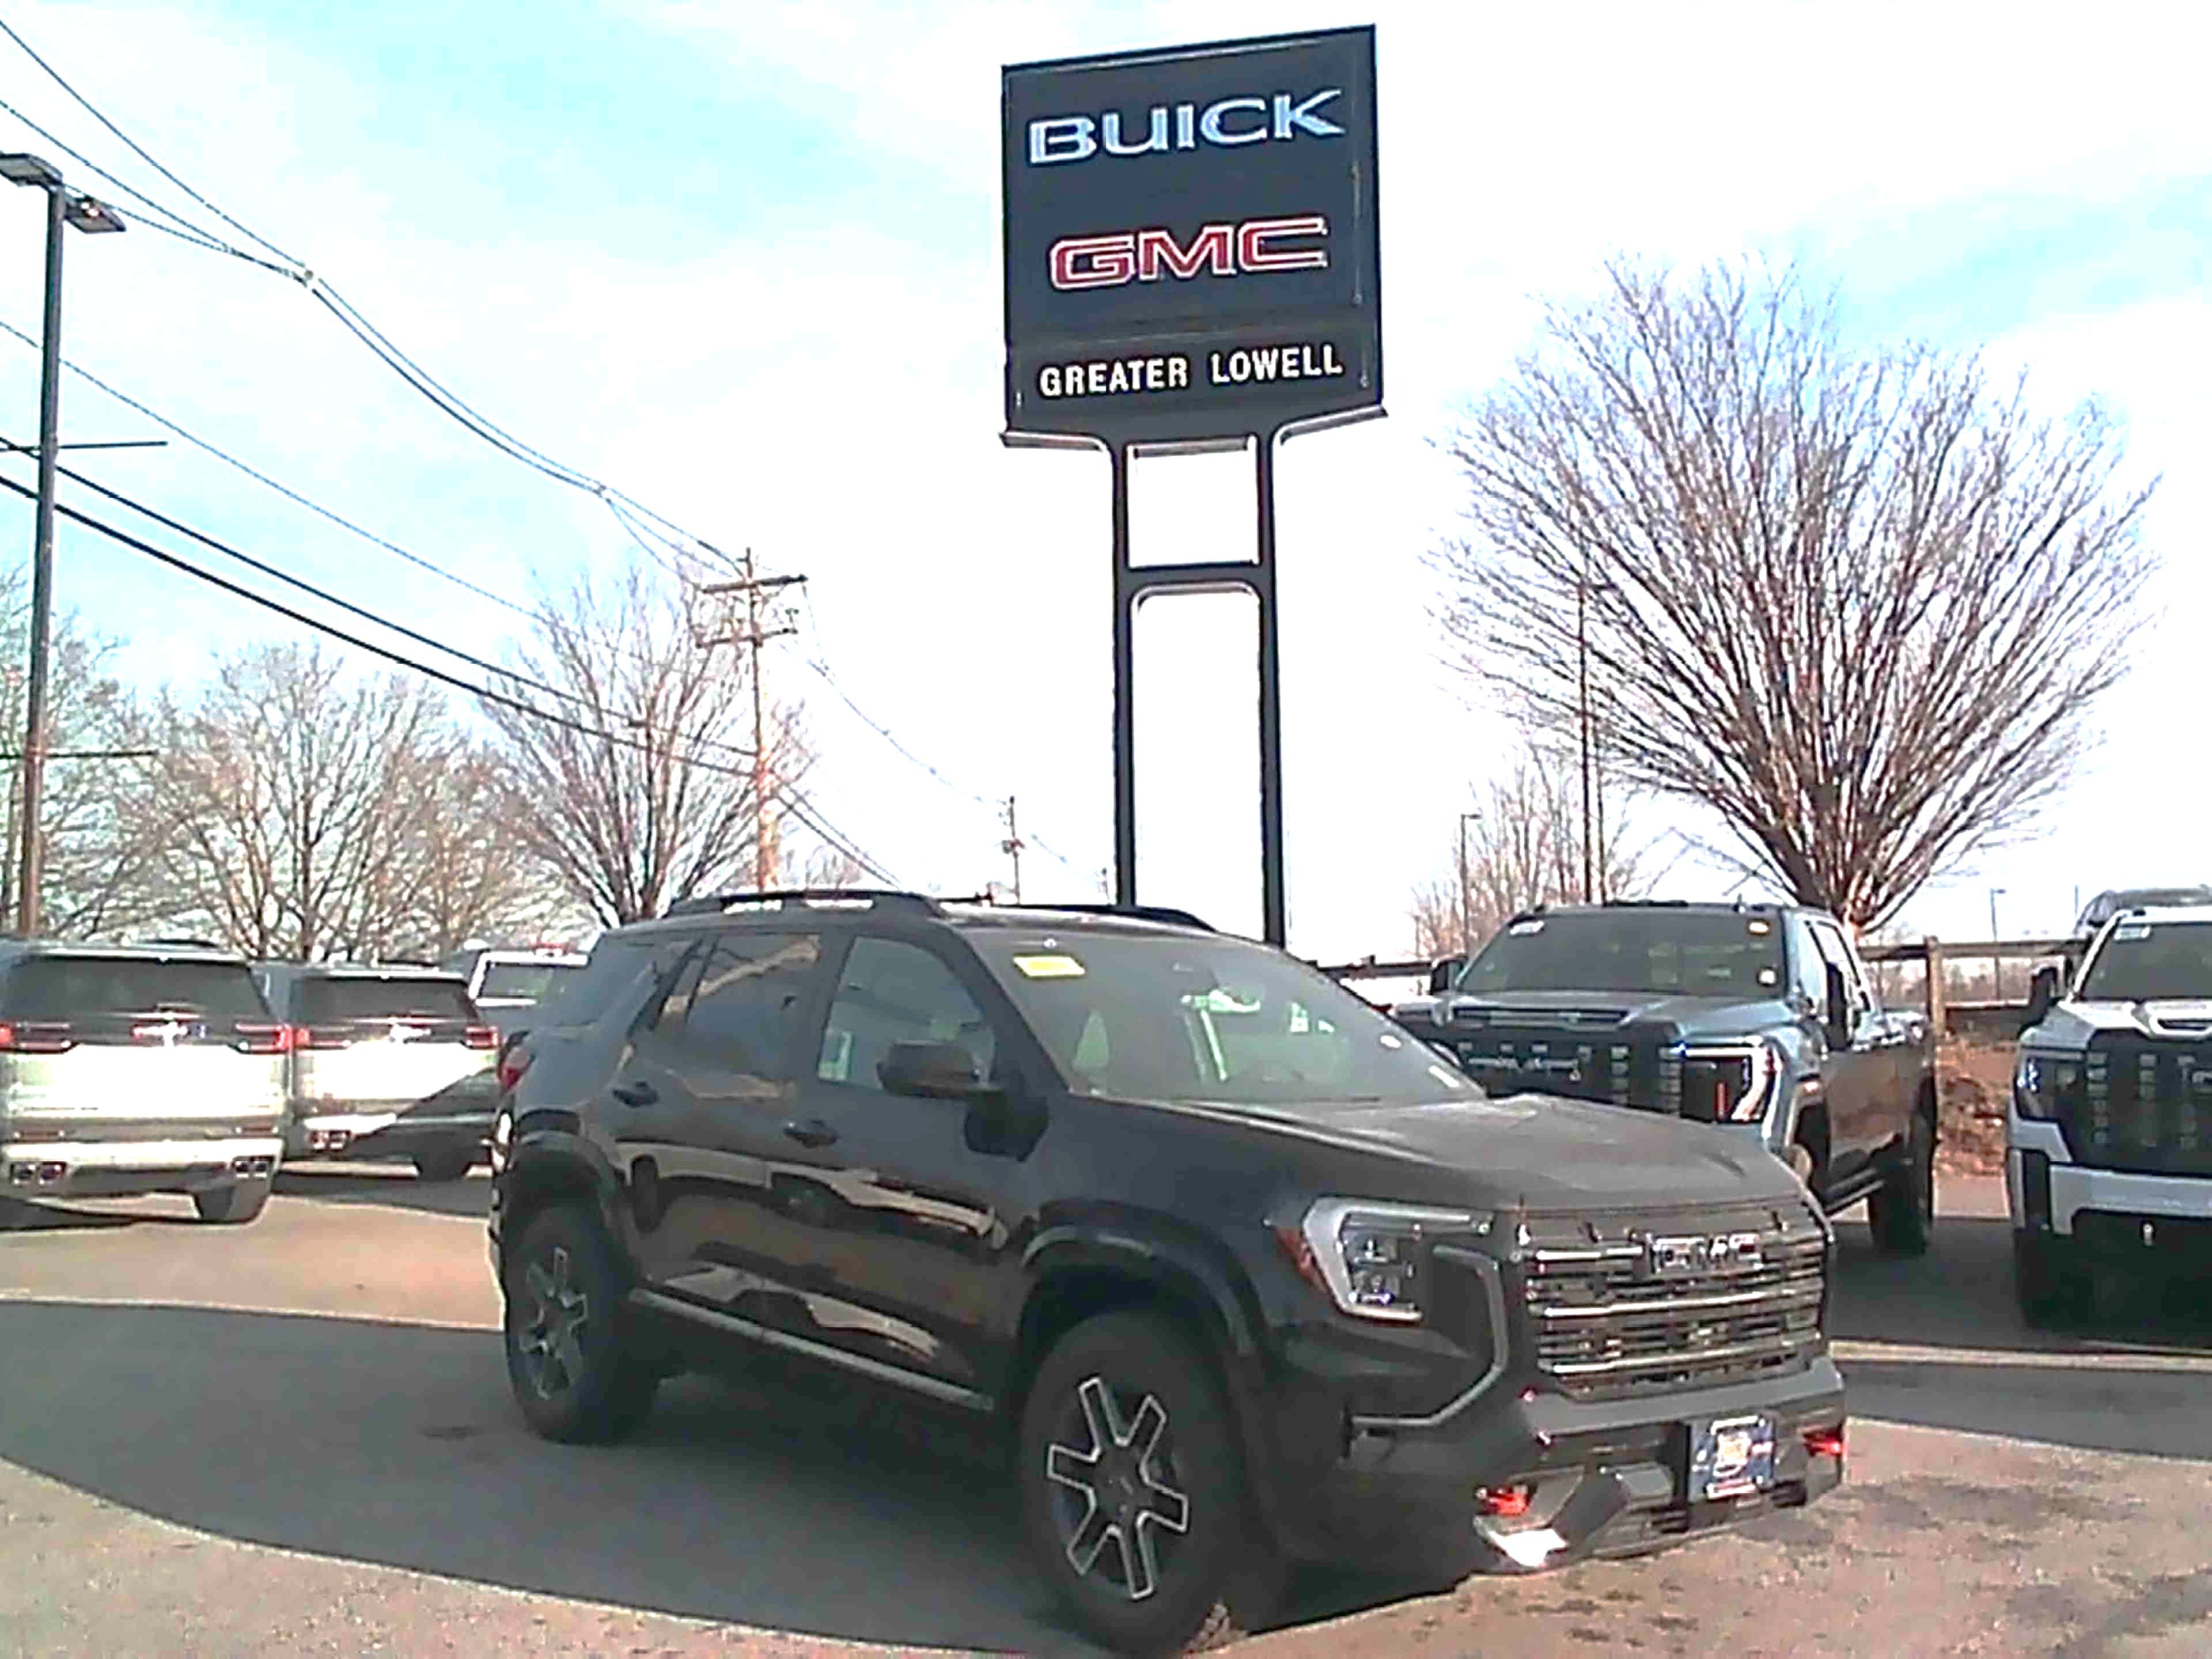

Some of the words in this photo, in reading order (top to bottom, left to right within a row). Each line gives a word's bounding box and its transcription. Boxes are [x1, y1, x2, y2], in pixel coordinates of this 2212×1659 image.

[1029, 89, 1346, 163] BUICK
[1050, 217, 1328, 290] GMC
[1040, 357, 1189, 397] GREATER
[1211, 344, 1344, 384] LOWELL
